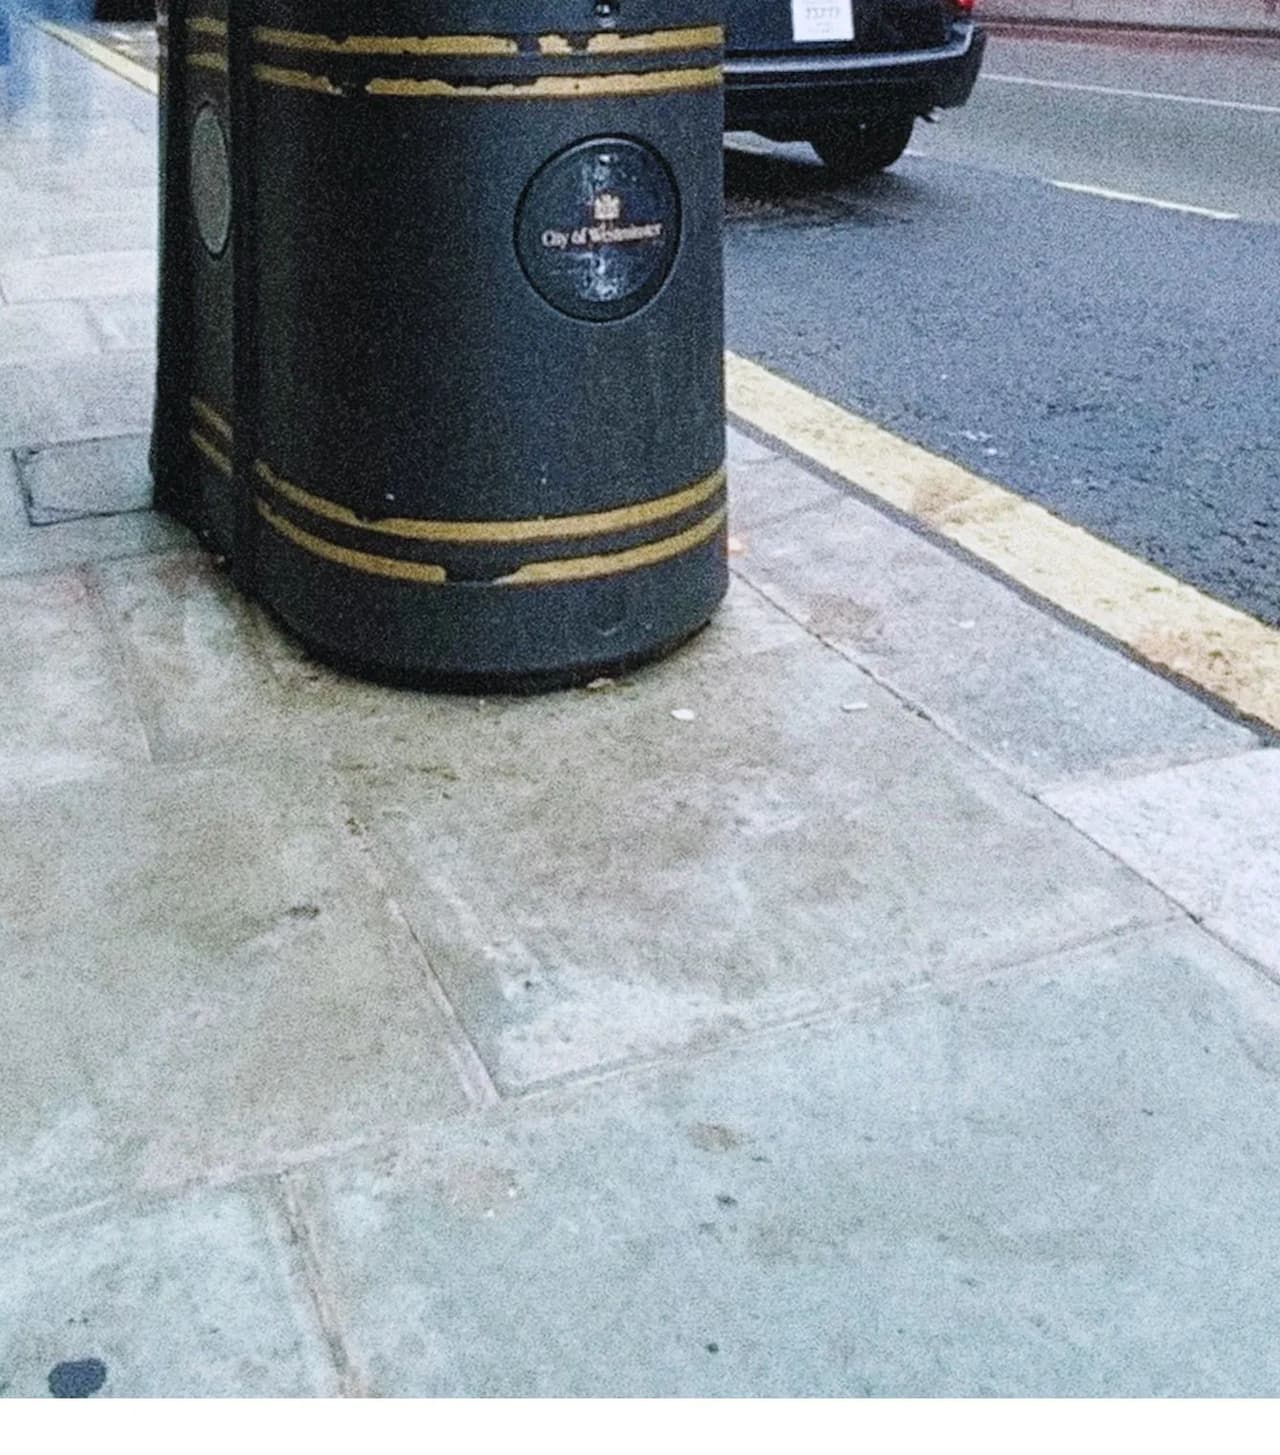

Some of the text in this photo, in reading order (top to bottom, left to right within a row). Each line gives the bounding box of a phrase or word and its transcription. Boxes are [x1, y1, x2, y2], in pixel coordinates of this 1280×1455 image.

[540, 223, 663, 250] City of Westminster
